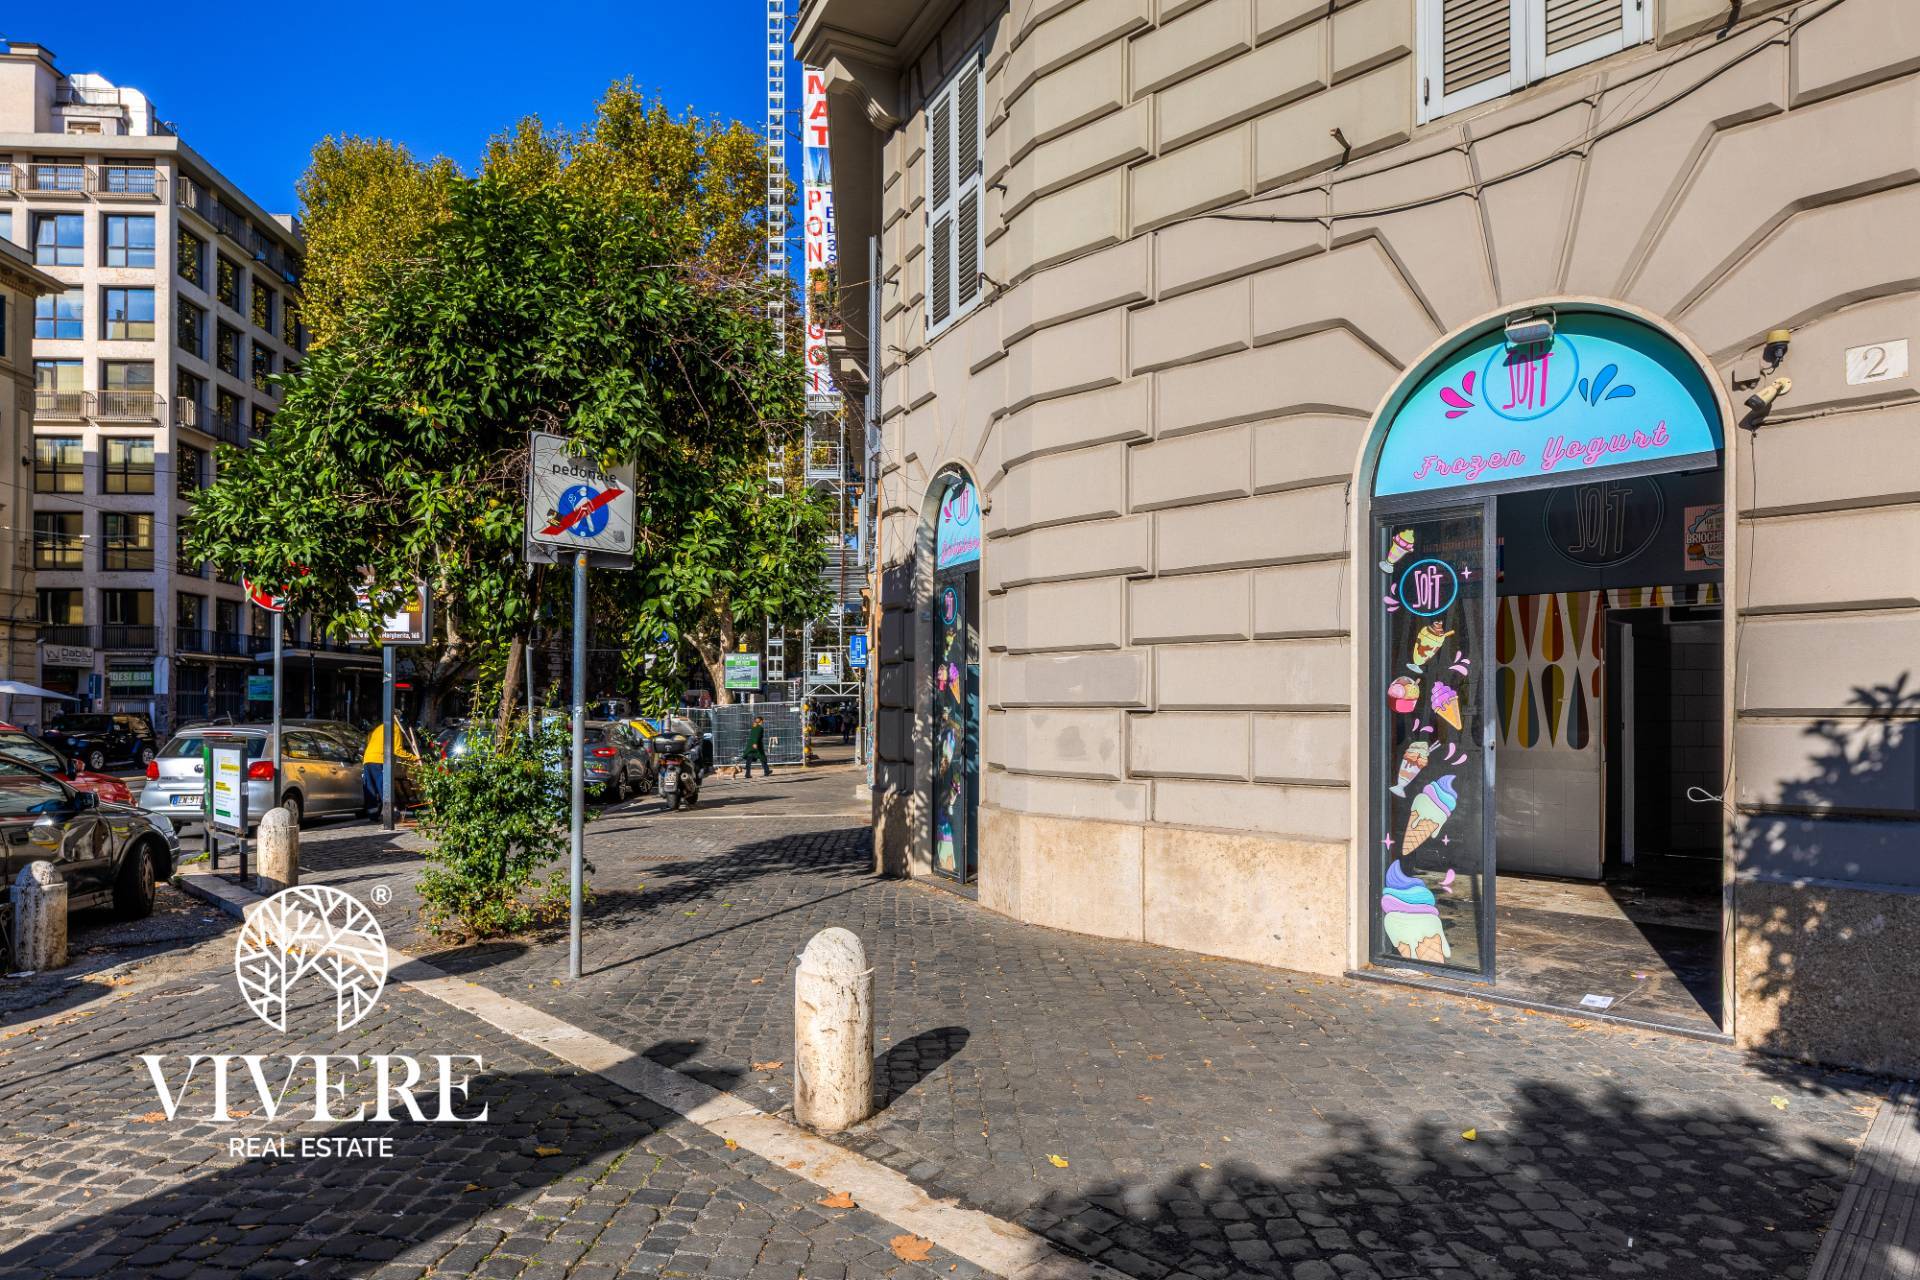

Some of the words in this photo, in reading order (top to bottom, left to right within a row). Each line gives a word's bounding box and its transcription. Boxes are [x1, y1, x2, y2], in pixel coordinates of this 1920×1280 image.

[806, 190, 825, 392] PONGGI
[1862, 346, 1888, 379] 2
[1413, 449, 1526, 481] Frozen
[1541, 420, 1670, 470] Yogurt
